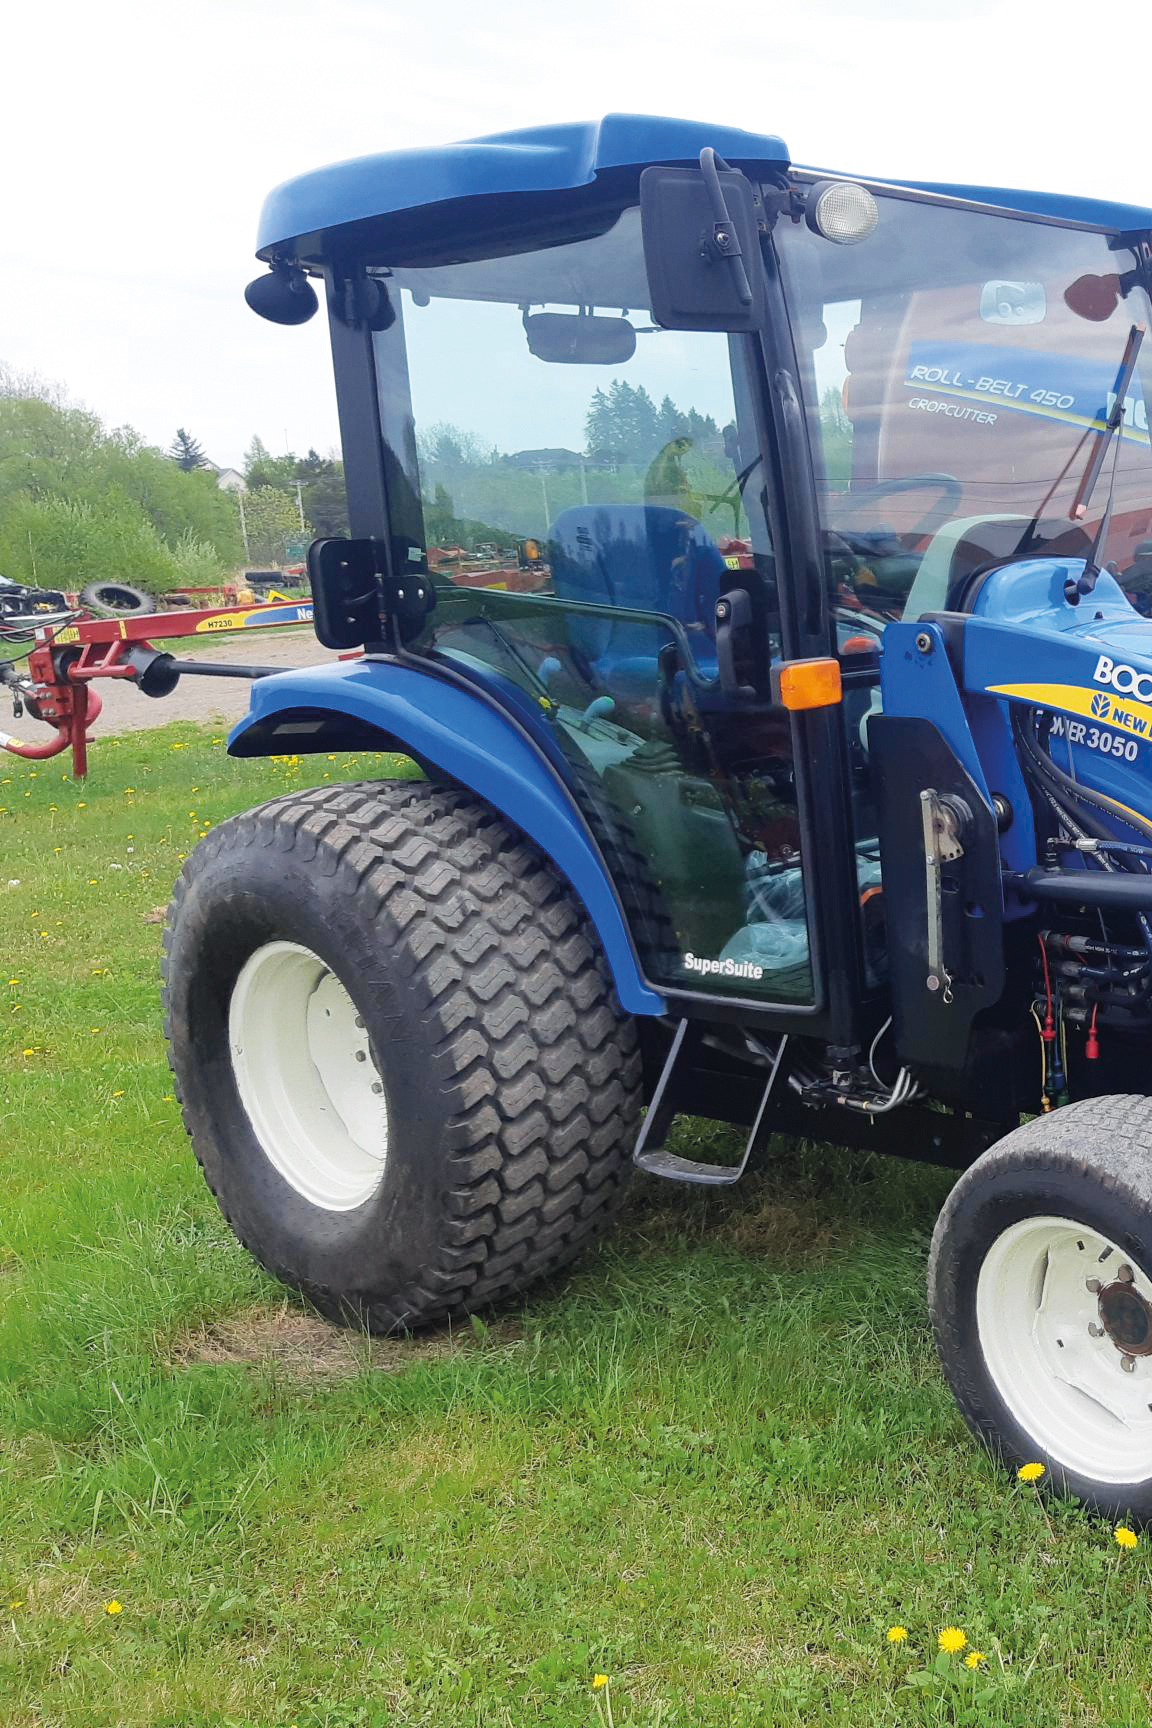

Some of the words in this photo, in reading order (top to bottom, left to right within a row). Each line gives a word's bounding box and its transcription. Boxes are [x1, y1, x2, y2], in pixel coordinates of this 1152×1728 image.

[908, 397, 998, 426] CROPCUTTER
[1030, 389, 1075, 410] 450
[1112, 707, 1148, 734] NEW
[1086, 727, 1139, 762] 3050
[684, 951, 764, 979] SuperSuite
